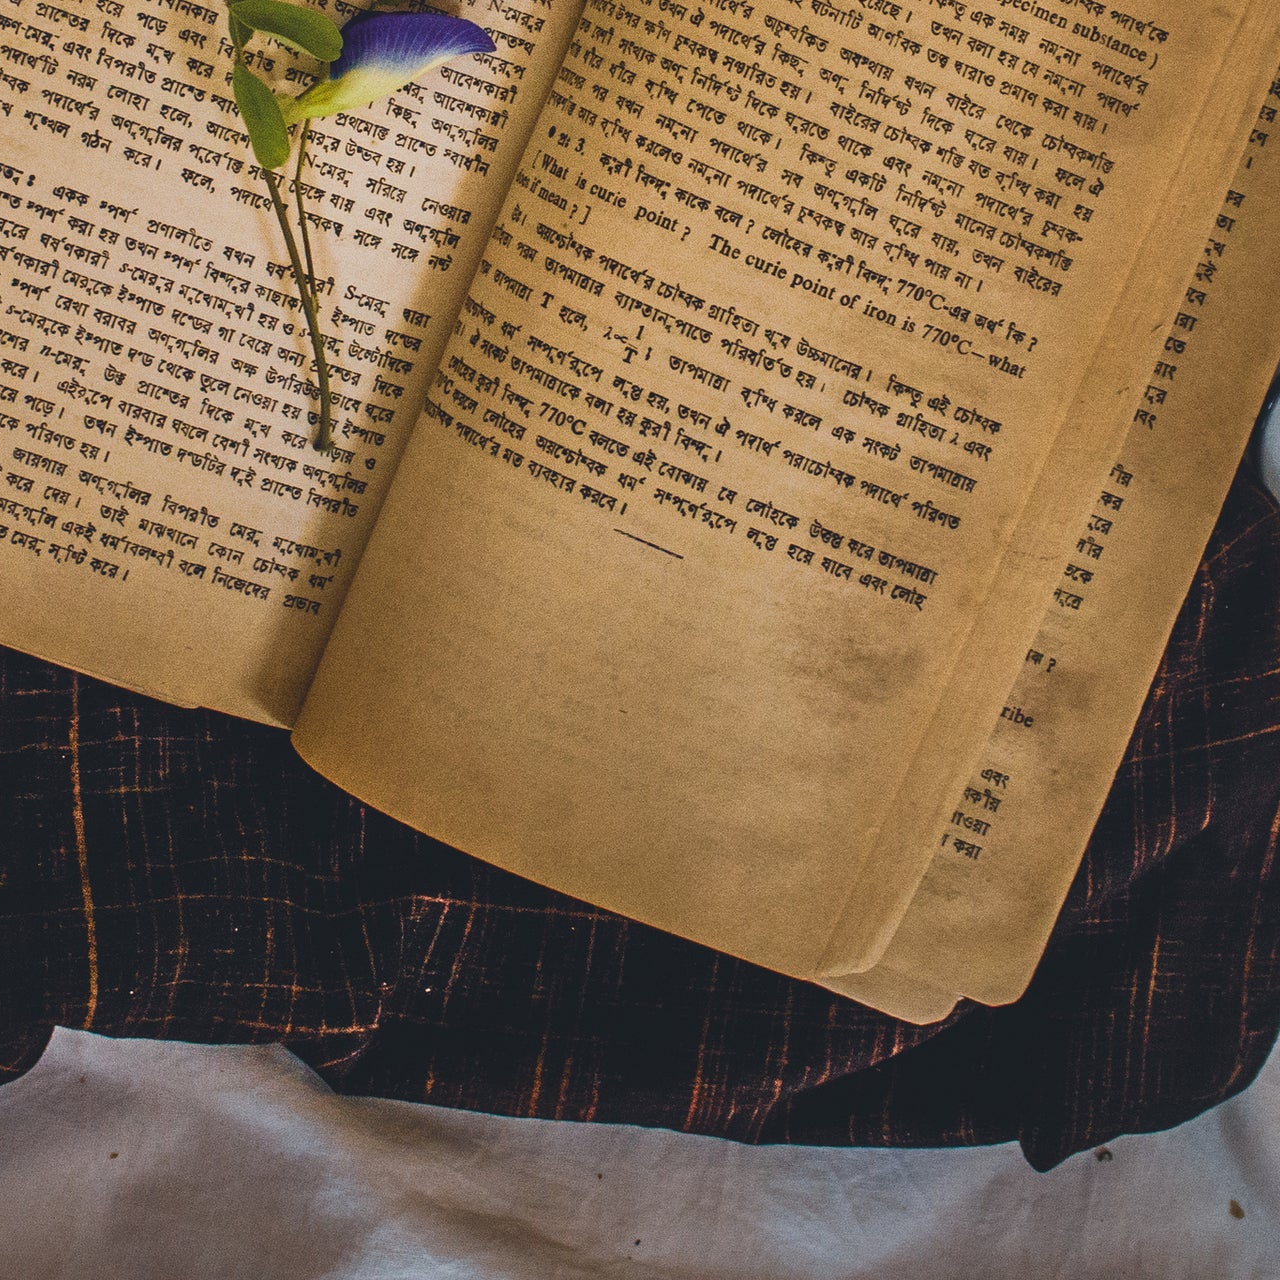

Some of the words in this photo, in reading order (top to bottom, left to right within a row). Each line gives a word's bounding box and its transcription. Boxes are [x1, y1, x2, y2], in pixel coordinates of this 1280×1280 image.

[1070, 21, 1148, 62] substance
[573, 170, 588, 190] is
[588, 183, 627, 209] curie
[632, 204, 679, 233] point
[707, 232, 742, 260] The
[743, 253, 788, 280] curie
[788, 272, 837, 301] point
[838, 293, 862, 310] of
[861, 298, 897, 327] iron
[899, 314, 916, 333] is
